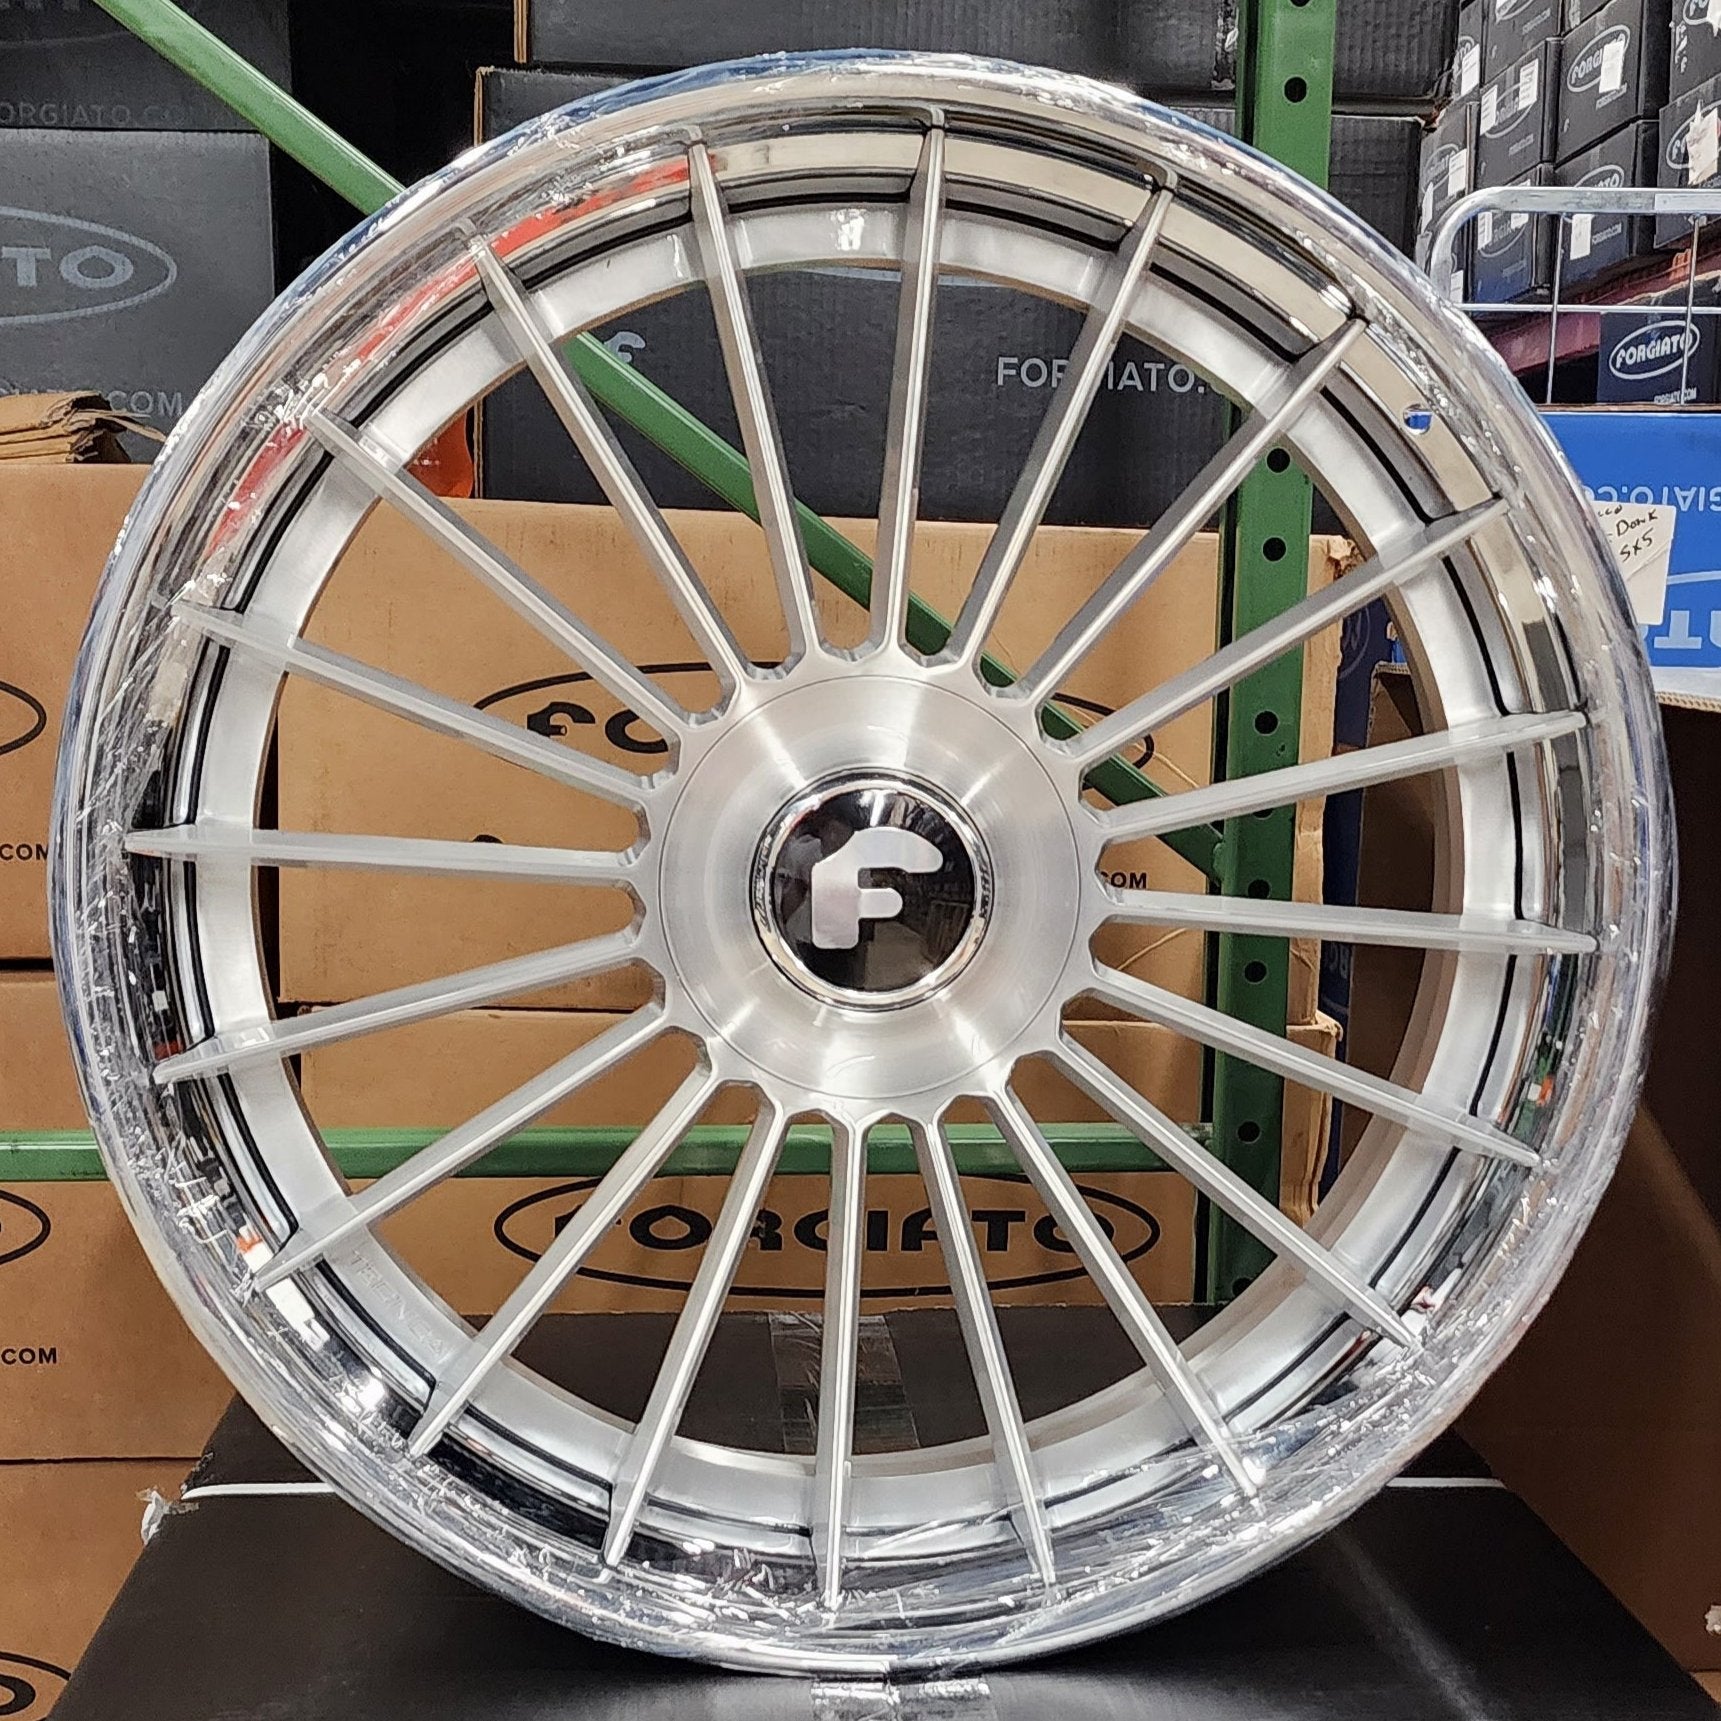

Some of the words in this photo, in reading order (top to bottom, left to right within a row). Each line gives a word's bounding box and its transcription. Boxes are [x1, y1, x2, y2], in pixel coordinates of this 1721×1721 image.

[1, 245, 134, 289] TO
[1616, 332, 1693, 369] FORGIATO
[997, 357, 1223, 394] FORIATO.
[554, 1202, 1115, 1252] ORIATO
[1, 1347, 57, 1365] COM
